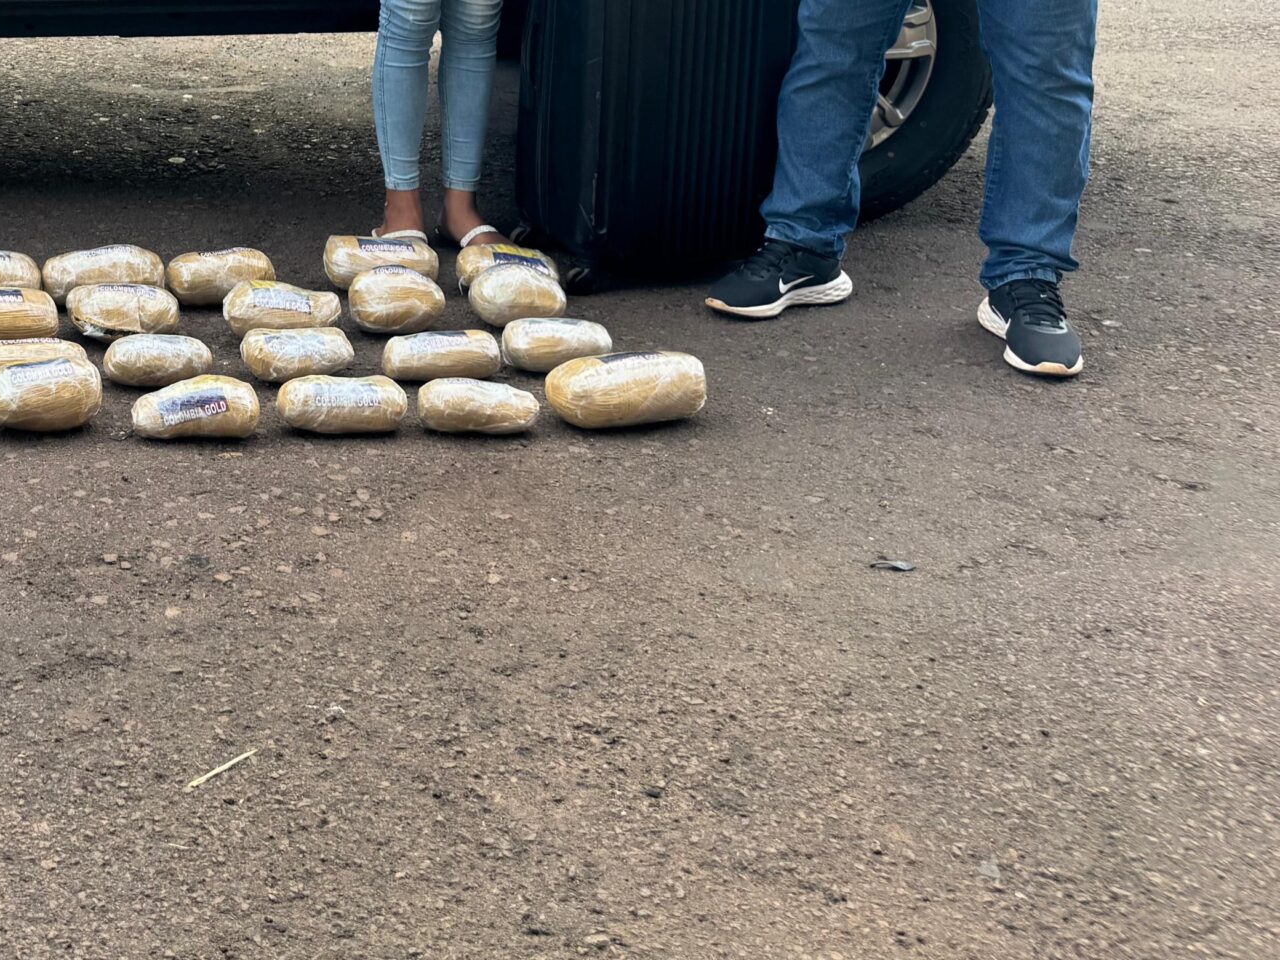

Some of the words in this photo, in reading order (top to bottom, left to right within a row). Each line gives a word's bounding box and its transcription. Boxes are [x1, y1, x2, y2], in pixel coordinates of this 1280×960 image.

[3, 295, 23, 303] GOLD
[357, 396, 379, 407] GOLD
[164, 407, 204, 426] COLOMBIA
[205, 401, 227, 416] GOLD
